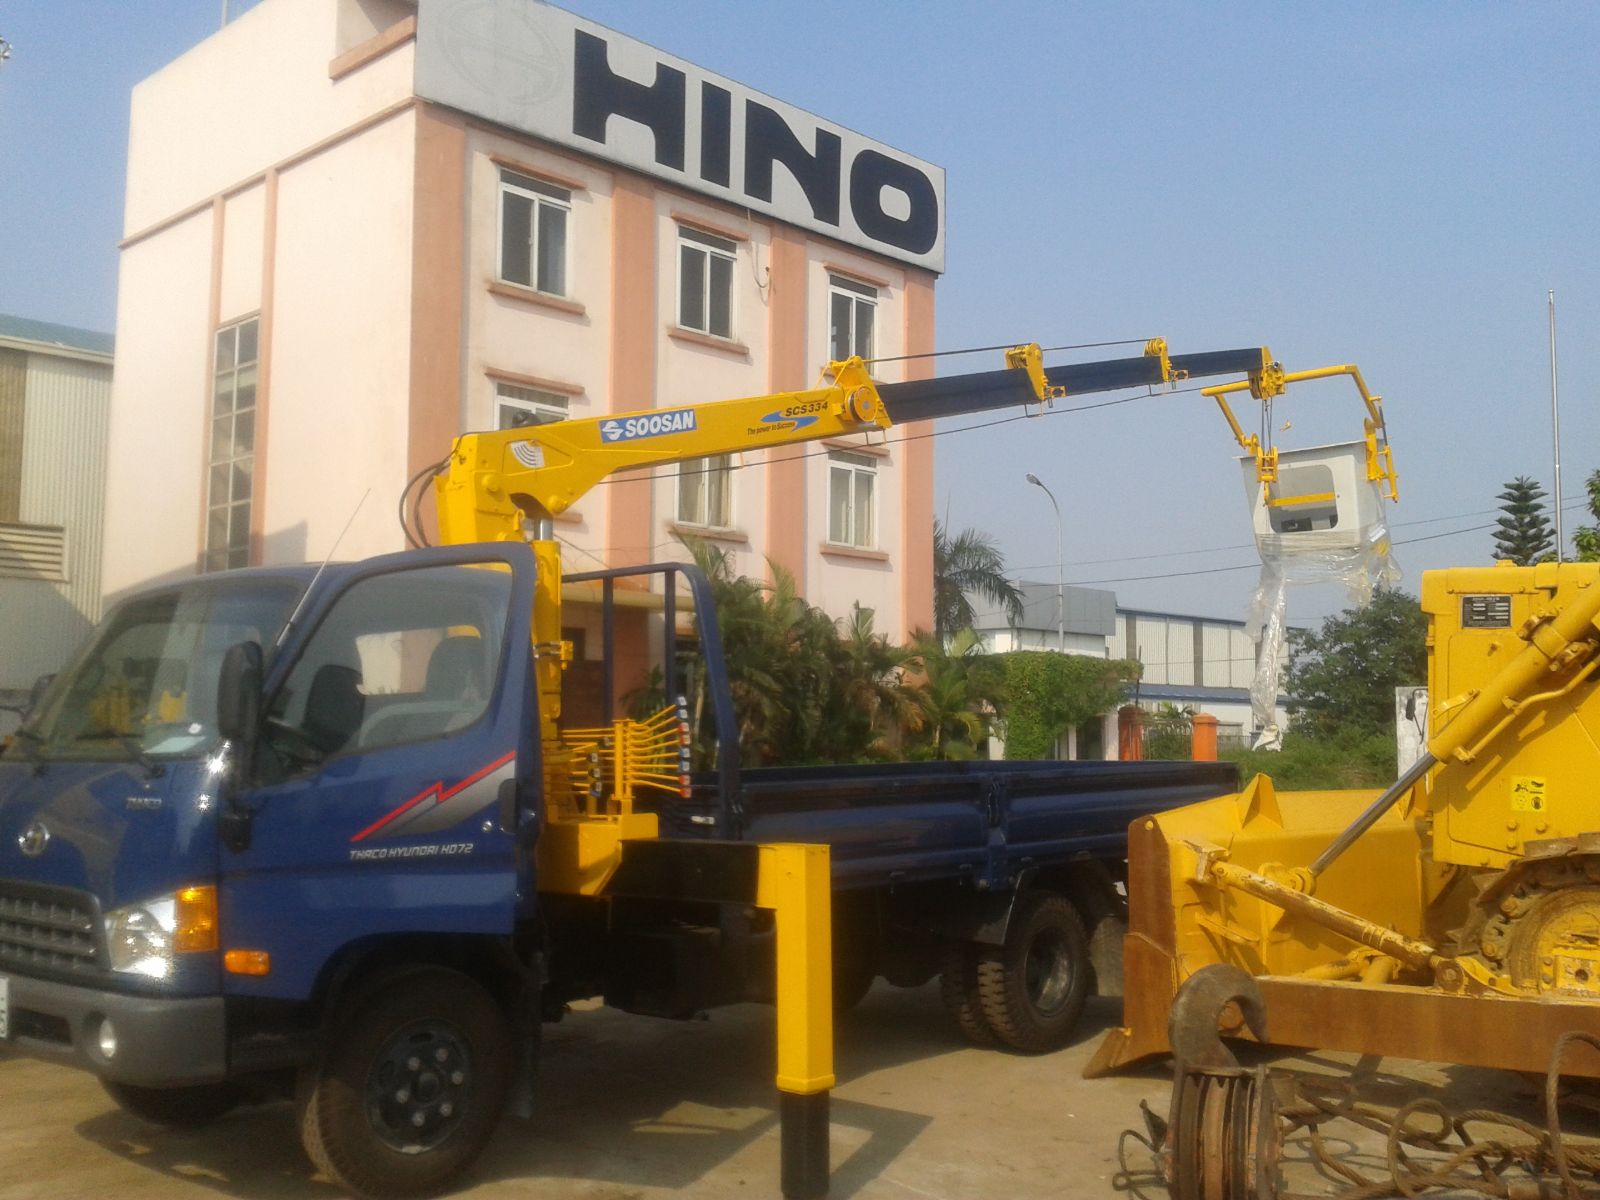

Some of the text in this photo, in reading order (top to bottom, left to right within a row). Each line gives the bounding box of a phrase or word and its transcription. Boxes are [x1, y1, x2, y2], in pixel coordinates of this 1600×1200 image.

[572, 28, 939, 256] HINO
[785, 401, 828, 417] SCS334
[625, 410, 694, 438] SOOSAN
[350, 843, 474, 860] THACO HYUNDAI HD72
